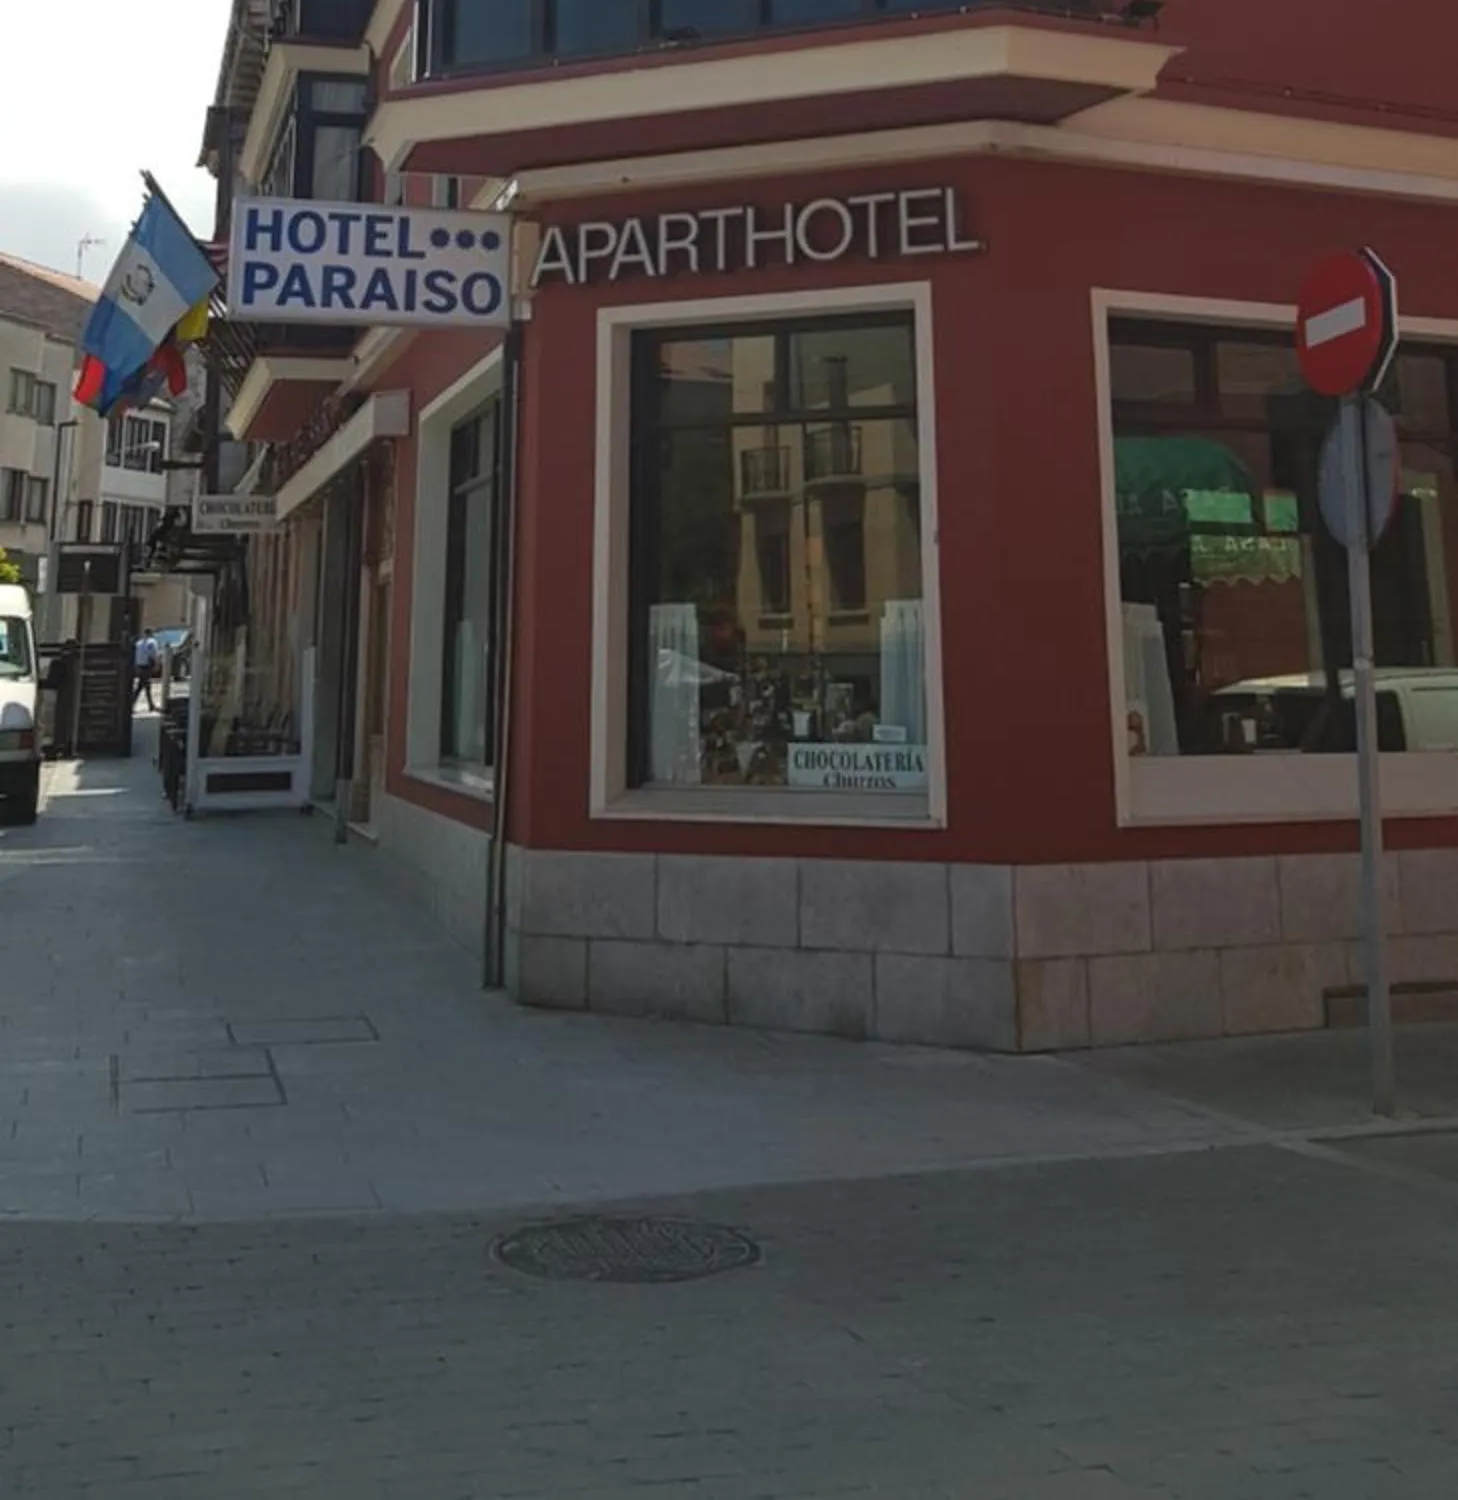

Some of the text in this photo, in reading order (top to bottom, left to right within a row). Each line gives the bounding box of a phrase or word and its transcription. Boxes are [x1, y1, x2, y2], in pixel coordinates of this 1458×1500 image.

[244, 208, 426, 260] HOTEL
[529, 187, 979, 287] APARTHOTEL
[241, 261, 502, 316] PARAISO
[794, 748, 924, 773] CHOCOLATERÍA
[822, 771, 897, 789] Churros
